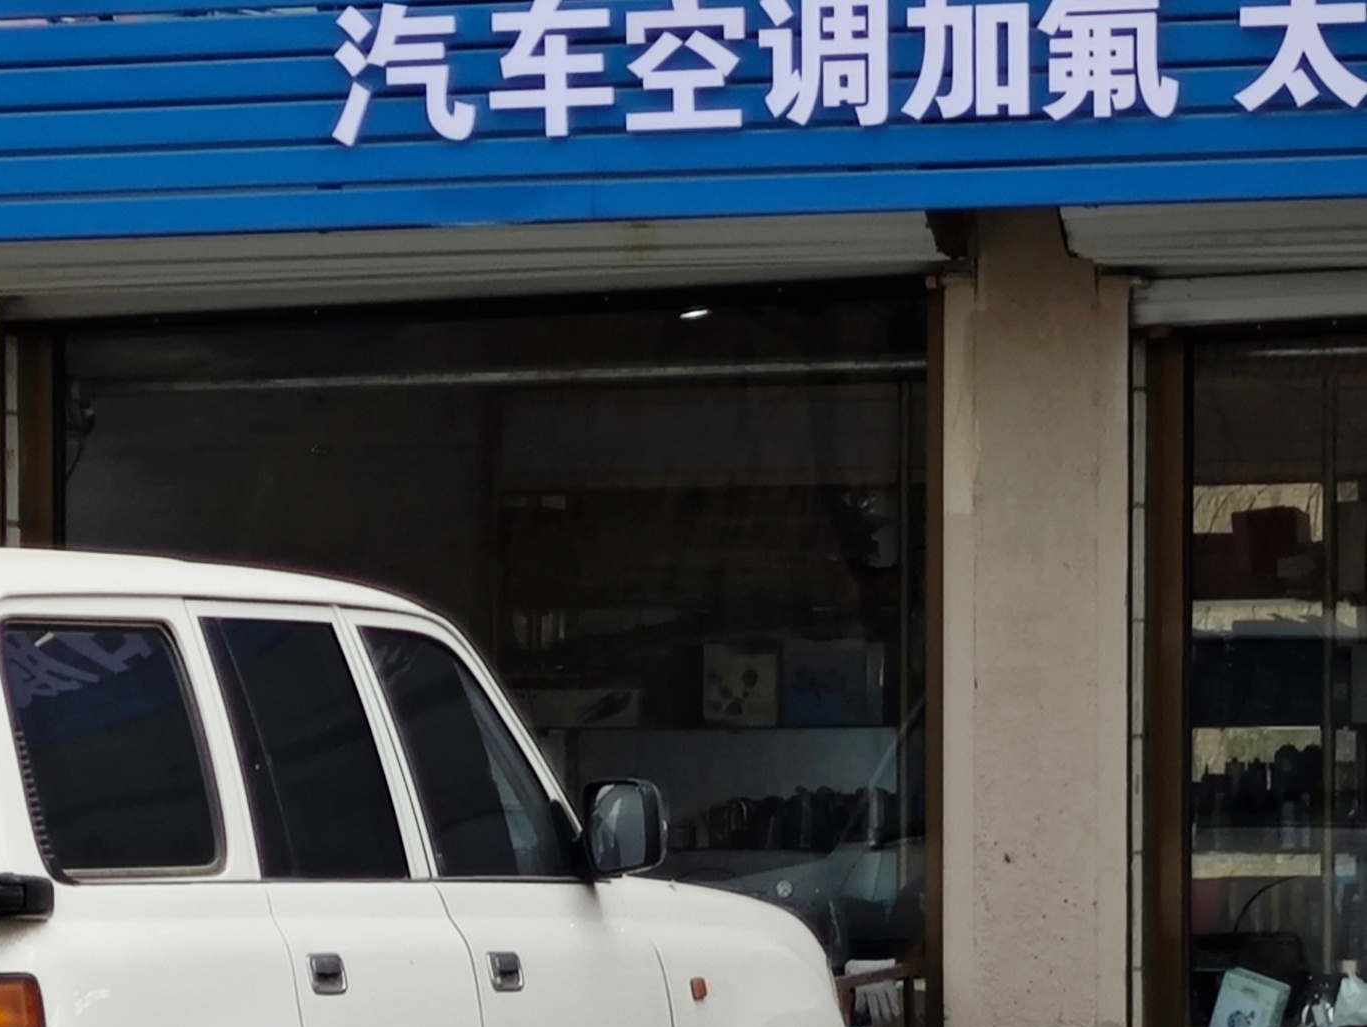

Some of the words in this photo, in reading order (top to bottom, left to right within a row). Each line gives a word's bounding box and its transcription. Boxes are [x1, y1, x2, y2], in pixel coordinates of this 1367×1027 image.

[332, 0, 1180, 147] 汽车空调加氟
[1234, 0, 1367, 113] 太
